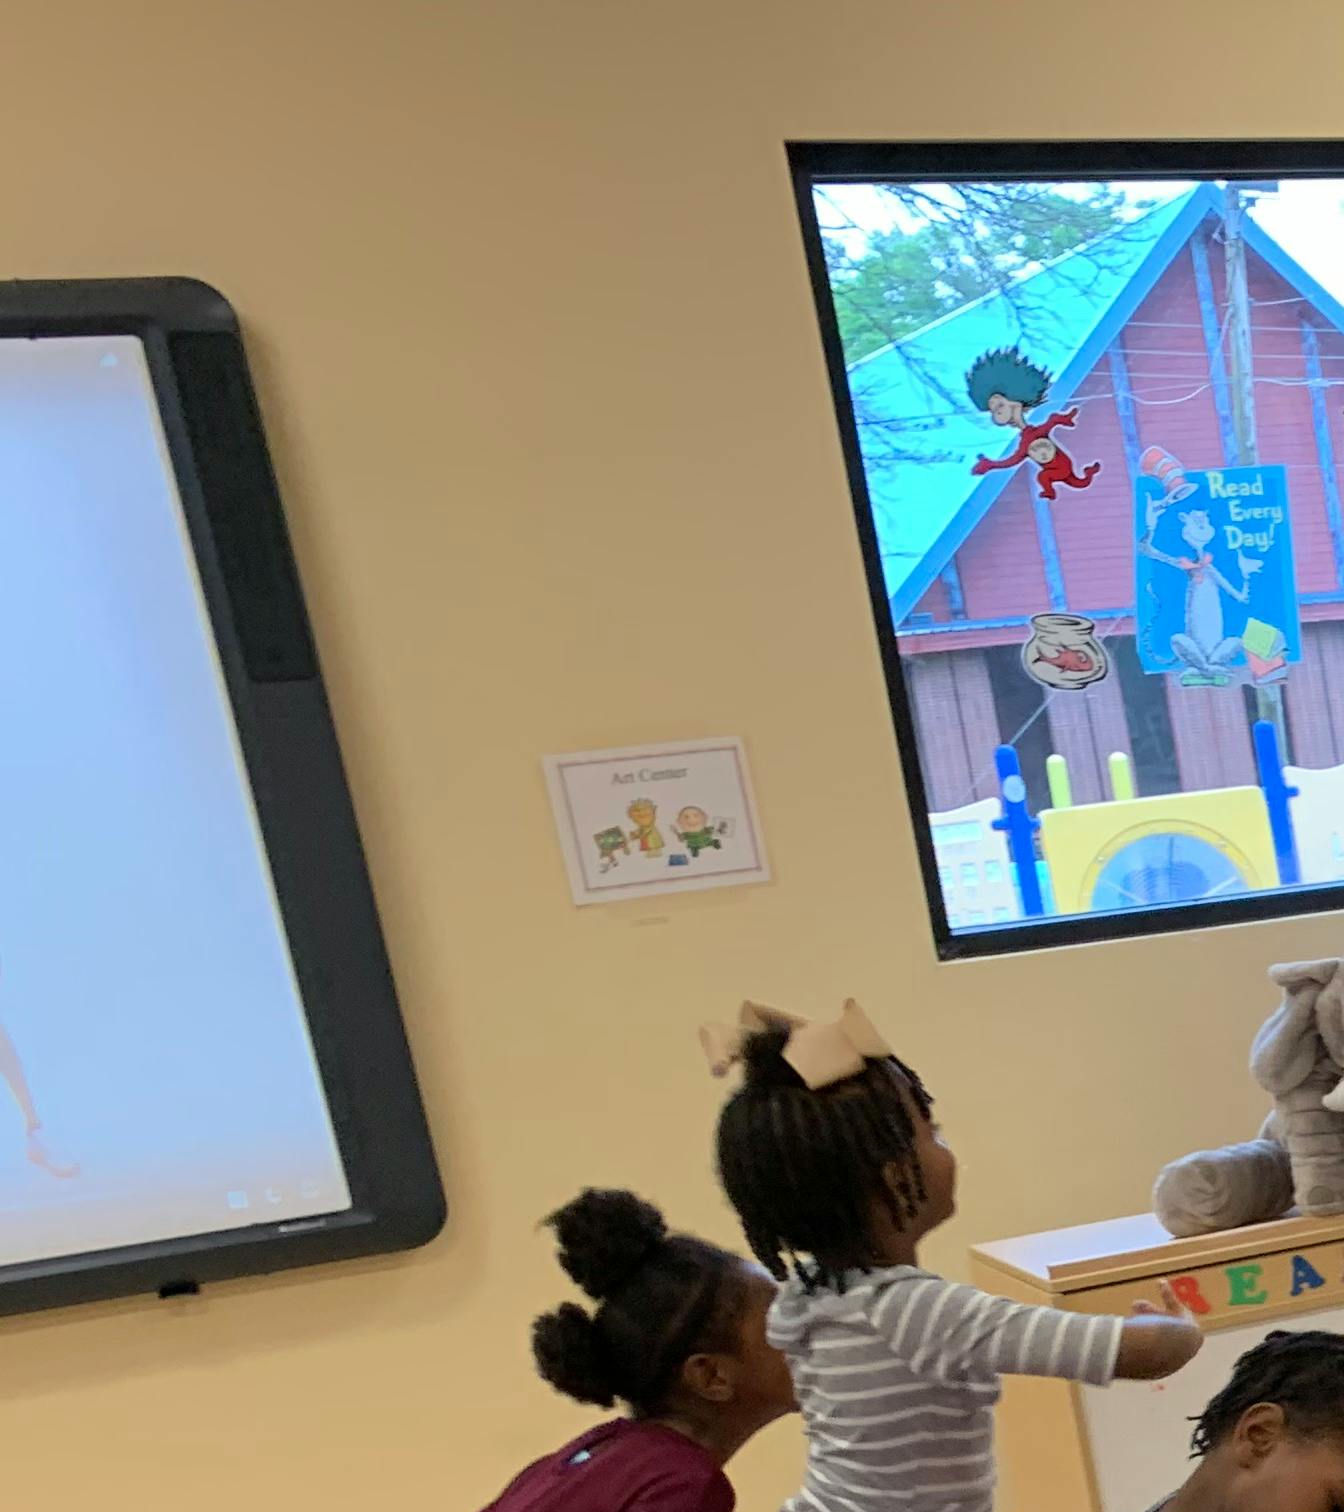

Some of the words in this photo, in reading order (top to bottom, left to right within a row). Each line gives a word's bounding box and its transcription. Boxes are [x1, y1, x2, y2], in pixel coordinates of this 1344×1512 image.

[1205, 471, 1264, 499] Read
[1228, 499, 1283, 524] Every
[1223, 523, 1276, 552] Day!
[611, 771, 636, 785] Art
[638, 768, 687, 782] Center
